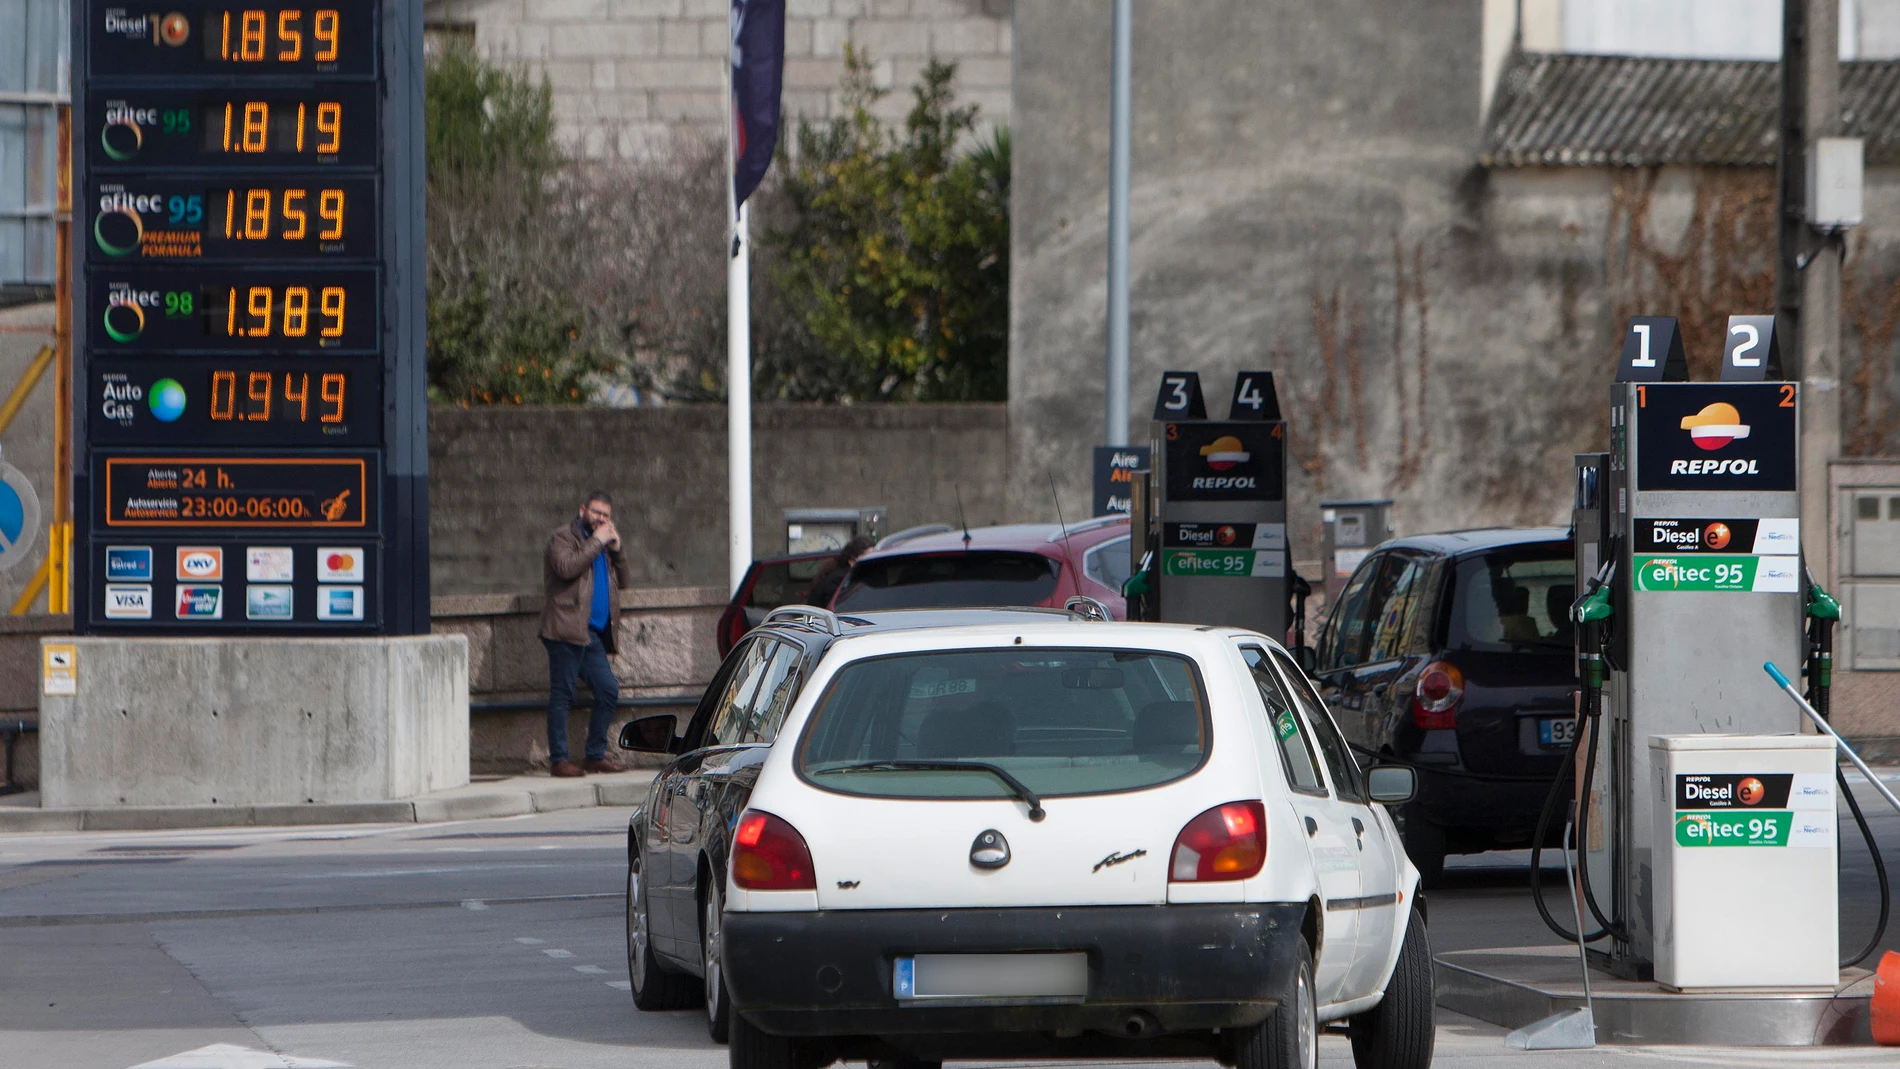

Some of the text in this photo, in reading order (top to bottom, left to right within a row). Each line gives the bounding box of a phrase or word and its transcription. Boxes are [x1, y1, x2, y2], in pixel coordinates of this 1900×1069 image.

[221, 10, 340, 61] 1.859
[162, 109, 191, 134] 95
[223, 102, 342, 153] 1.819
[168, 195, 203, 224] 95
[225, 189, 345, 240] 1.859
[142, 231, 200, 243] PREMIUM
[141, 245, 202, 257] FORMULA
[165, 291, 193, 316] 98
[227, 286, 346, 337] 1.989
[1632, 325, 1656, 367] 1
[1730, 324, 1760, 367] 2
[103, 382, 142, 400] Auto
[210, 370, 346, 423] 0.949
[1164, 378, 1188, 410] 3
[1237, 378, 1263, 410] 4
[1637, 386, 1646, 408] 1
[1779, 385, 1795, 407] 2
[102, 400, 134, 419] Gas
[1167, 425, 1178, 440] 3
[1271, 424, 1282, 440] 4
[1110, 452, 1139, 468] Aire
[1670, 459, 1760, 475] REPSOL
[182, 467, 234, 489] 24 h.
[1110, 468, 1132, 482] Air
[1192, 477, 1256, 489] REPSOL
[1179, 529, 1213, 541] Diesel
[1653, 528, 1699, 543] Diesel
[1178, 556, 1220, 570] efitec
[1223, 556, 1245, 571] 95
[1653, 564, 1743, 583] efitec 95
[116, 595, 144, 606] VISA
[1553, 721, 1576, 740] 93
[1686, 783, 1732, 799] Diesel
[1686, 819, 1777, 839] efitec 95
[901, 982, 908, 991] P
